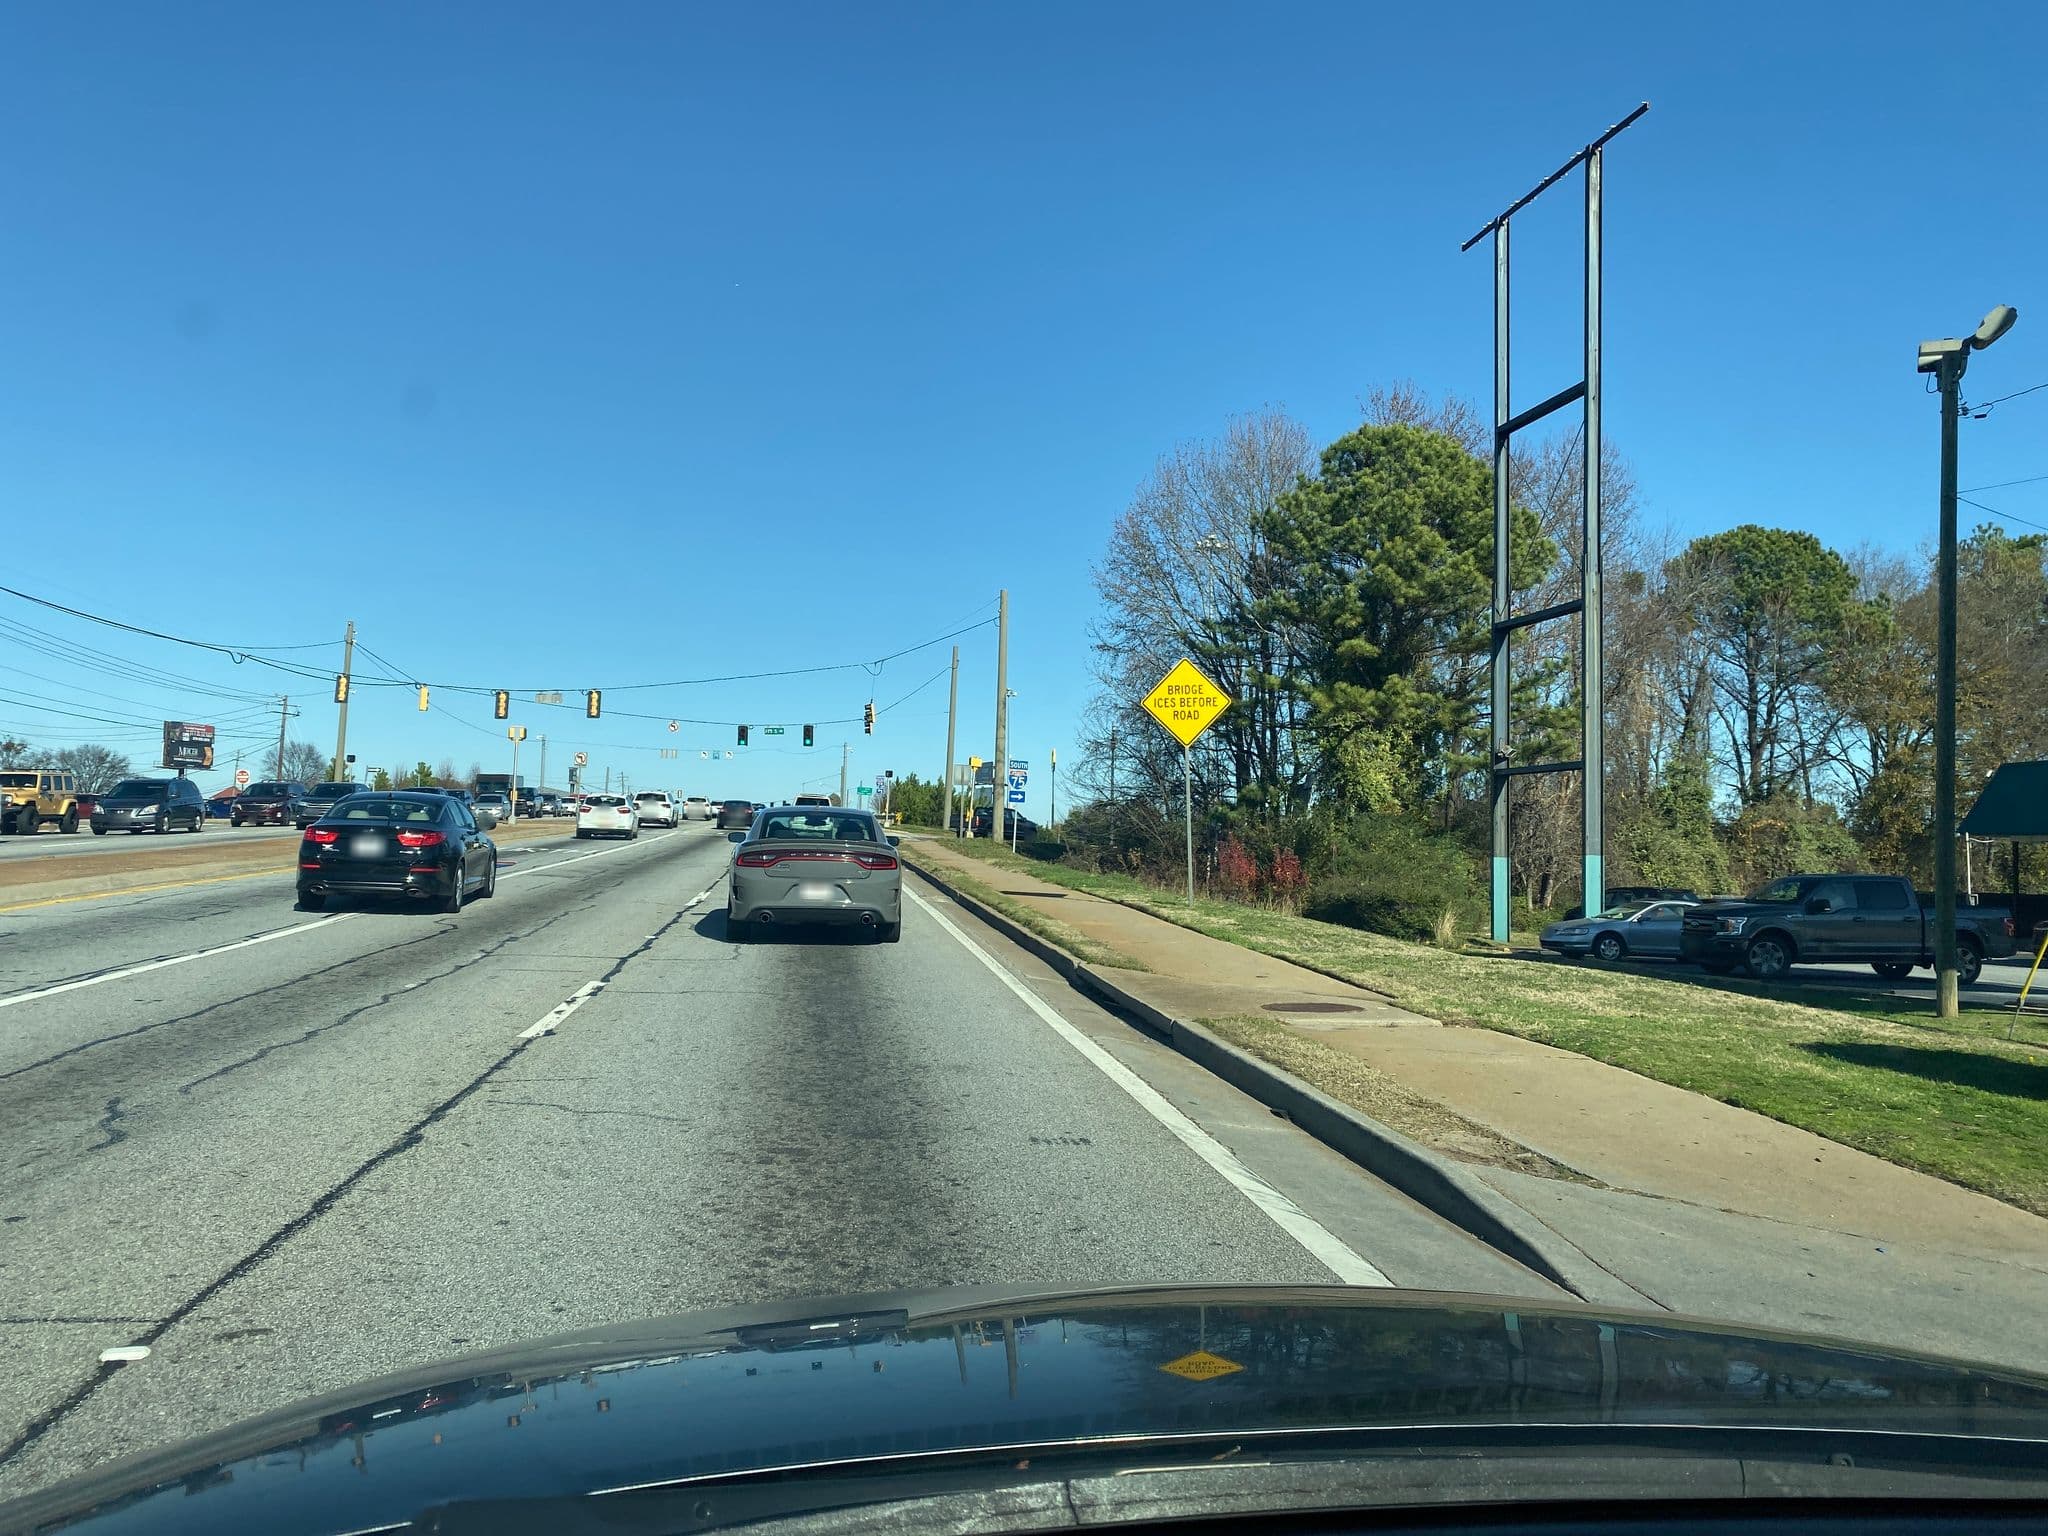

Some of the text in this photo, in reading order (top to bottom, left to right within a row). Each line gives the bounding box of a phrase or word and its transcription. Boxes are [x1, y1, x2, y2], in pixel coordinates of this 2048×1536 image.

[1168, 684, 1204, 694] BRIDGE
[1154, 697, 1218, 708] ICES BEFORE
[1173, 710, 1200, 720] ROAD
[1012, 776, 1024, 788] 75
